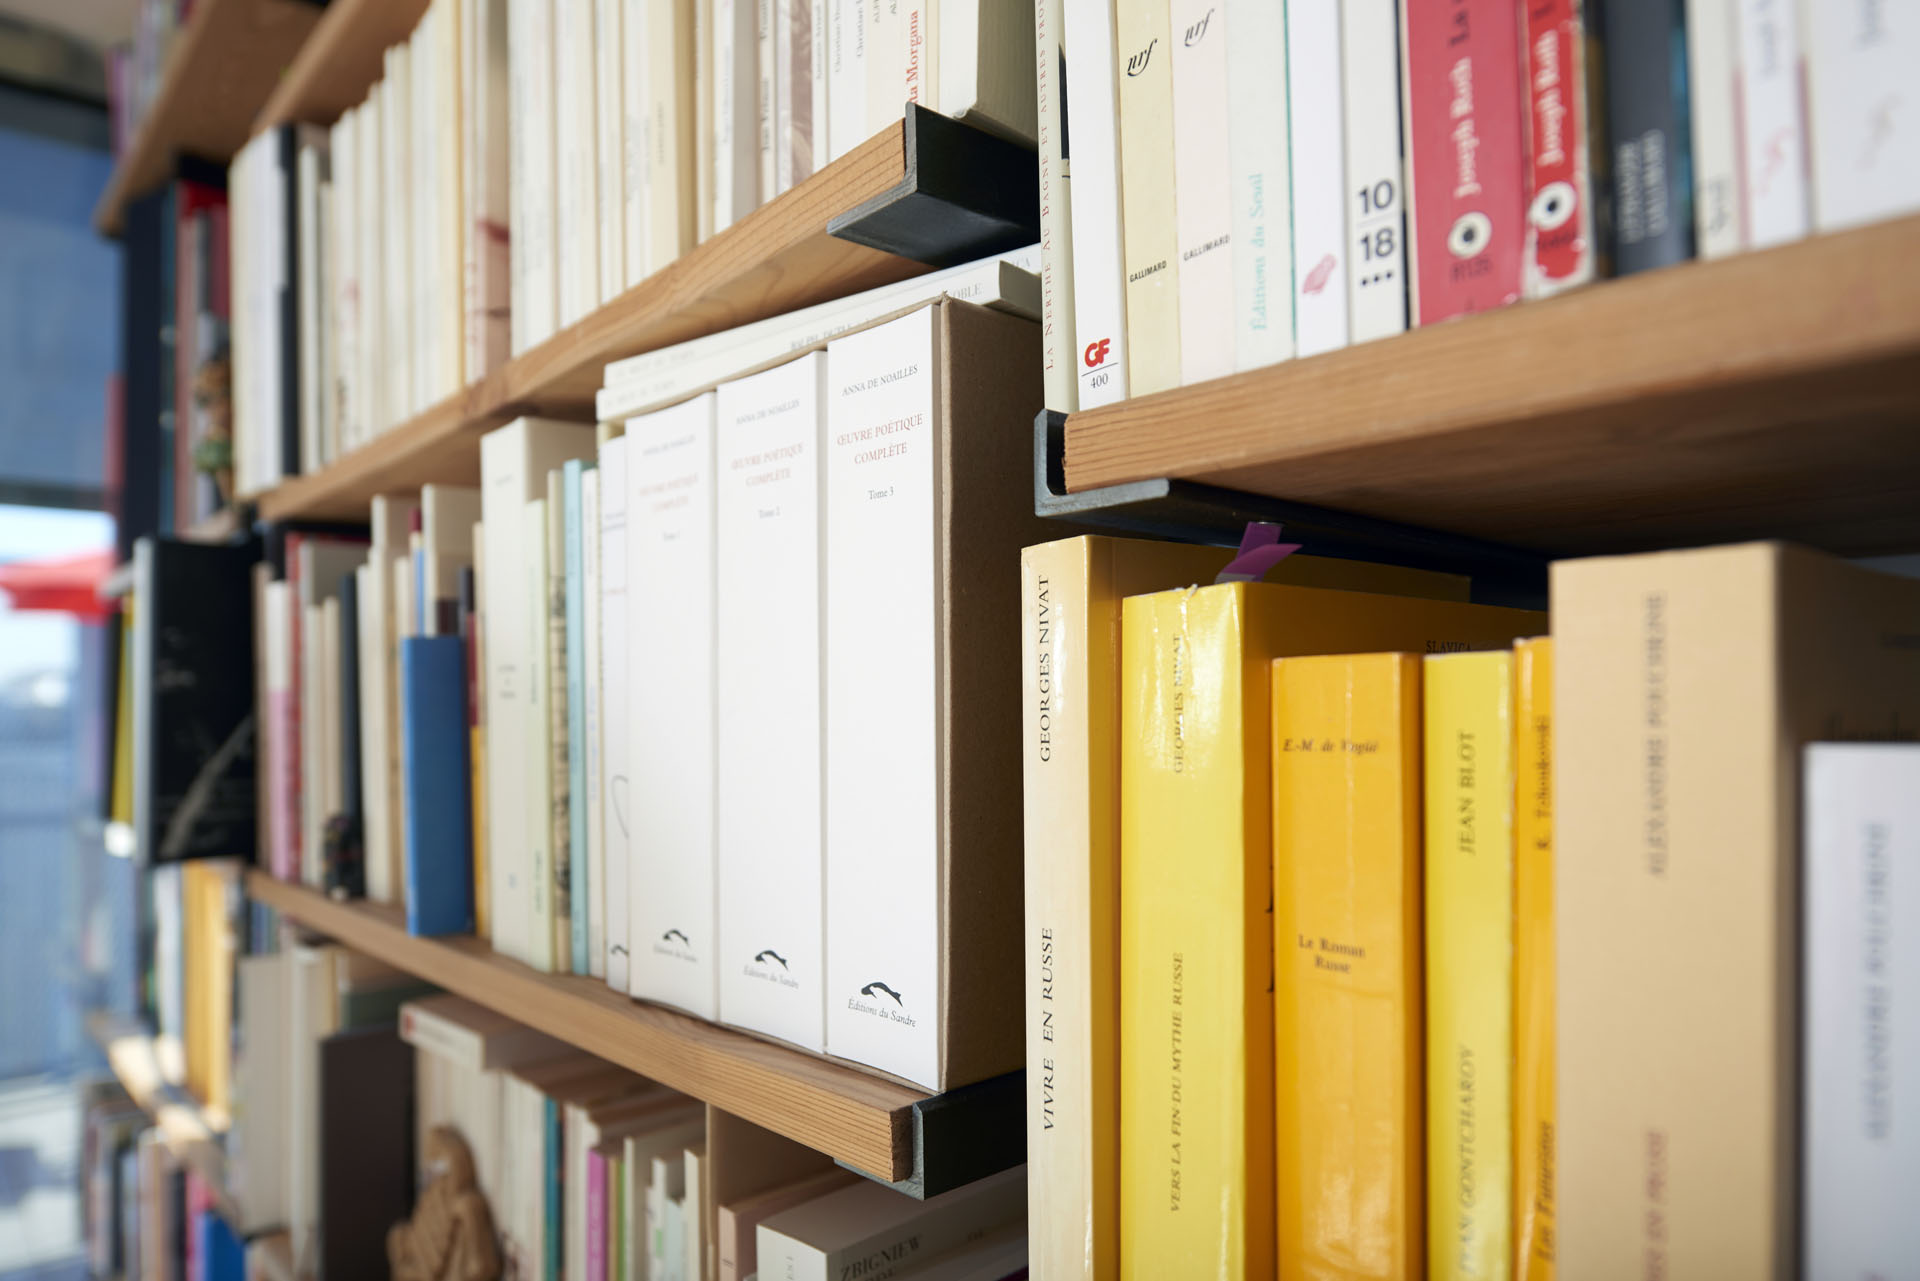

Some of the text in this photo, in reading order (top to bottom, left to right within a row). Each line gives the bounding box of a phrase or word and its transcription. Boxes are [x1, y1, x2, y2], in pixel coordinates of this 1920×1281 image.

[905, 10, 923, 84] Morgana
[1184, 8, 1215, 48] nrf
[1127, 38, 1158, 77] nrf
[1535, 30, 1559, 92] Roth
[1449, 56, 1472, 118] Roth
[1537, 88, 1565, 167] Joseph
[1452, 118, 1481, 199] Joseph
[1037, 0, 1054, 370] LA NERTHE AU BAGNE ET AUTRES PROS
[1249, 173, 1264, 219] Seuil
[1358, 179, 1394, 215] 10
[1183, 232, 1230, 261] GALLIMARD
[1250, 226, 1265, 250] du
[1359, 227, 1396, 263] 18
[1129, 259, 1167, 282] GALLIMARD
[950, 283, 983, 301] OBLE
[841, 364, 918, 397] ANNA DE NOAILLES
[1090, 373, 1109, 389] 400
[837, 427, 873, 447] ŒUVRE
[868, 486, 894, 501] Tome 3
[1038, 575, 1051, 762] GEORGES NIVAT
[1173, 634, 1184, 774] GEORGES NIVAT
[1458, 730, 1476, 856] JEAN BLOT
[1298, 934, 1365, 958] Le Roman
[879, 1007, 889, 1020] du
[890, 1010, 917, 1028] Sandre
[1042, 927, 1054, 1131] VIVRE EN RUSSE
[1171, 952, 1184, 1212] VERS LA FIN DU MYTHE RUSSE
[839, 1233, 923, 1281] ZBIGNIEW
